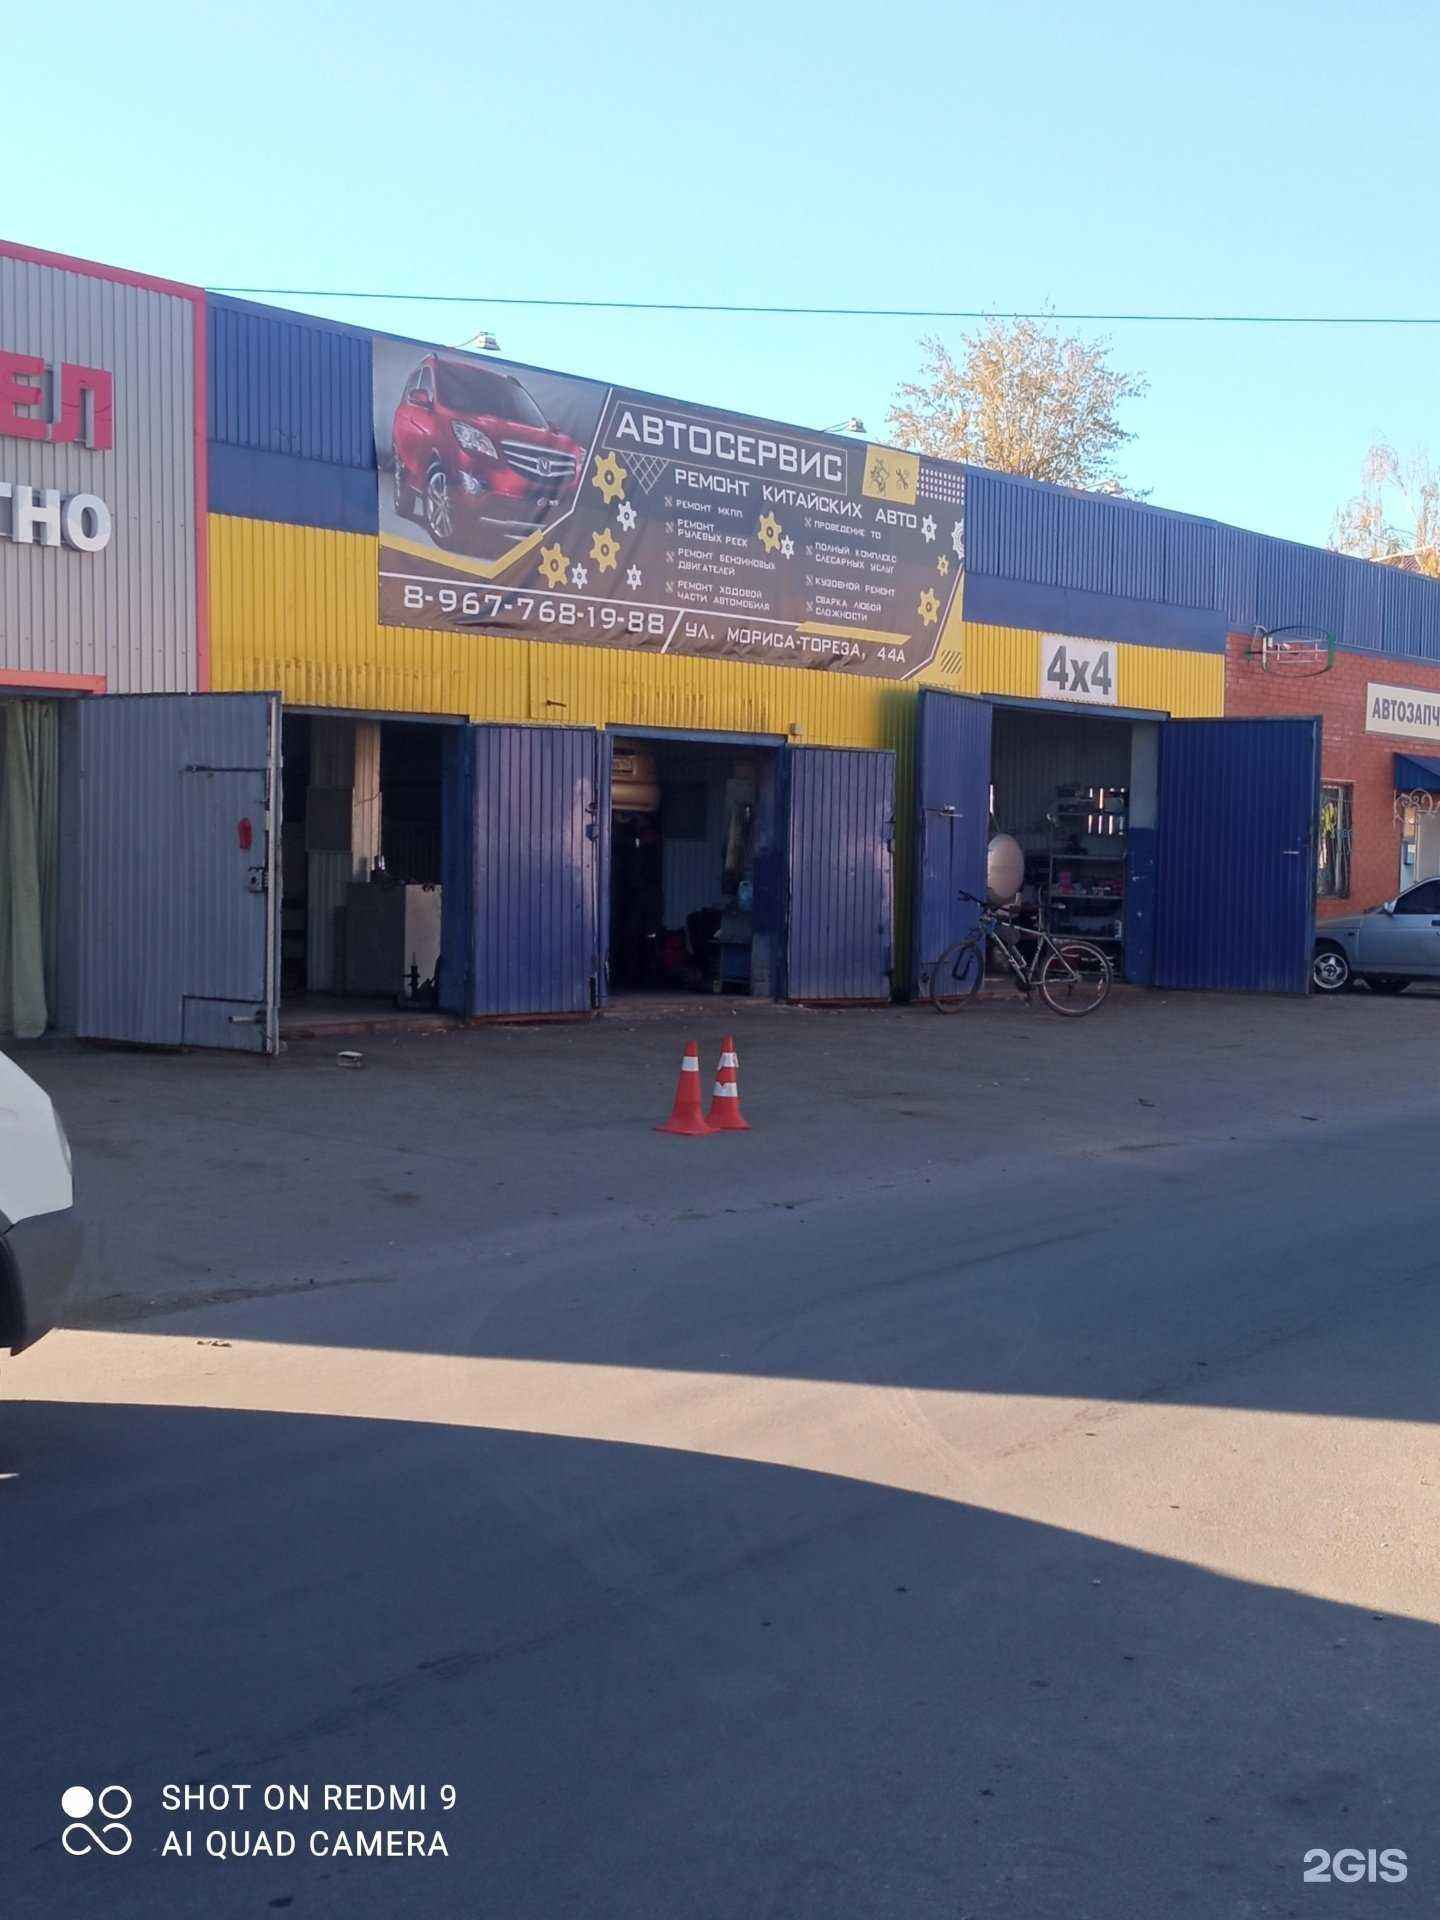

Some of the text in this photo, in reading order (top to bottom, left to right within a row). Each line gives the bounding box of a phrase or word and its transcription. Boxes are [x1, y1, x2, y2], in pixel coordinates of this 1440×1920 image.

[616, 412, 842, 482] АВТОСЕРВИС
[675, 469, 918, 529] РЕМОНТ КИТАЙСКИХ АВТО
[676, 499, 712, 513] РЕМОНТ
[677, 519, 715, 532] РЕМОНТ
[814, 520, 882, 539] ПРОВЕДЕНИЕ ТО
[677, 528, 748, 548] РУЛЕВЫХ РЕЕК
[815, 542, 850, 555] ПОЛНЫЙ
[678, 548, 776, 570] РЕМОНТ БЕНЗИНОВЫХ
[678, 561, 736, 576] ДВИГАТЕЛЕЙ
[815, 554, 895, 574] СЛЕСАРНЫХ УСЛУГ
[678, 580, 762, 599] РЕМОНТ ХОДОВОЙ
[815, 576, 895, 597] КУЗОВНОЙ РЕМОНТ
[404, 585, 665, 634] 8-967-768-19-88
[677, 592, 770, 611] ЧАСТИ АВТОМОБИЛЯ
[815, 596, 882, 613] СВАРКА ЛЮБОЙ
[815, 607, 868, 621] СЛОЖНОСТИ
[685, 622, 906, 663] УЛ. МОРИСА-ТОРЕЗА, 44А
